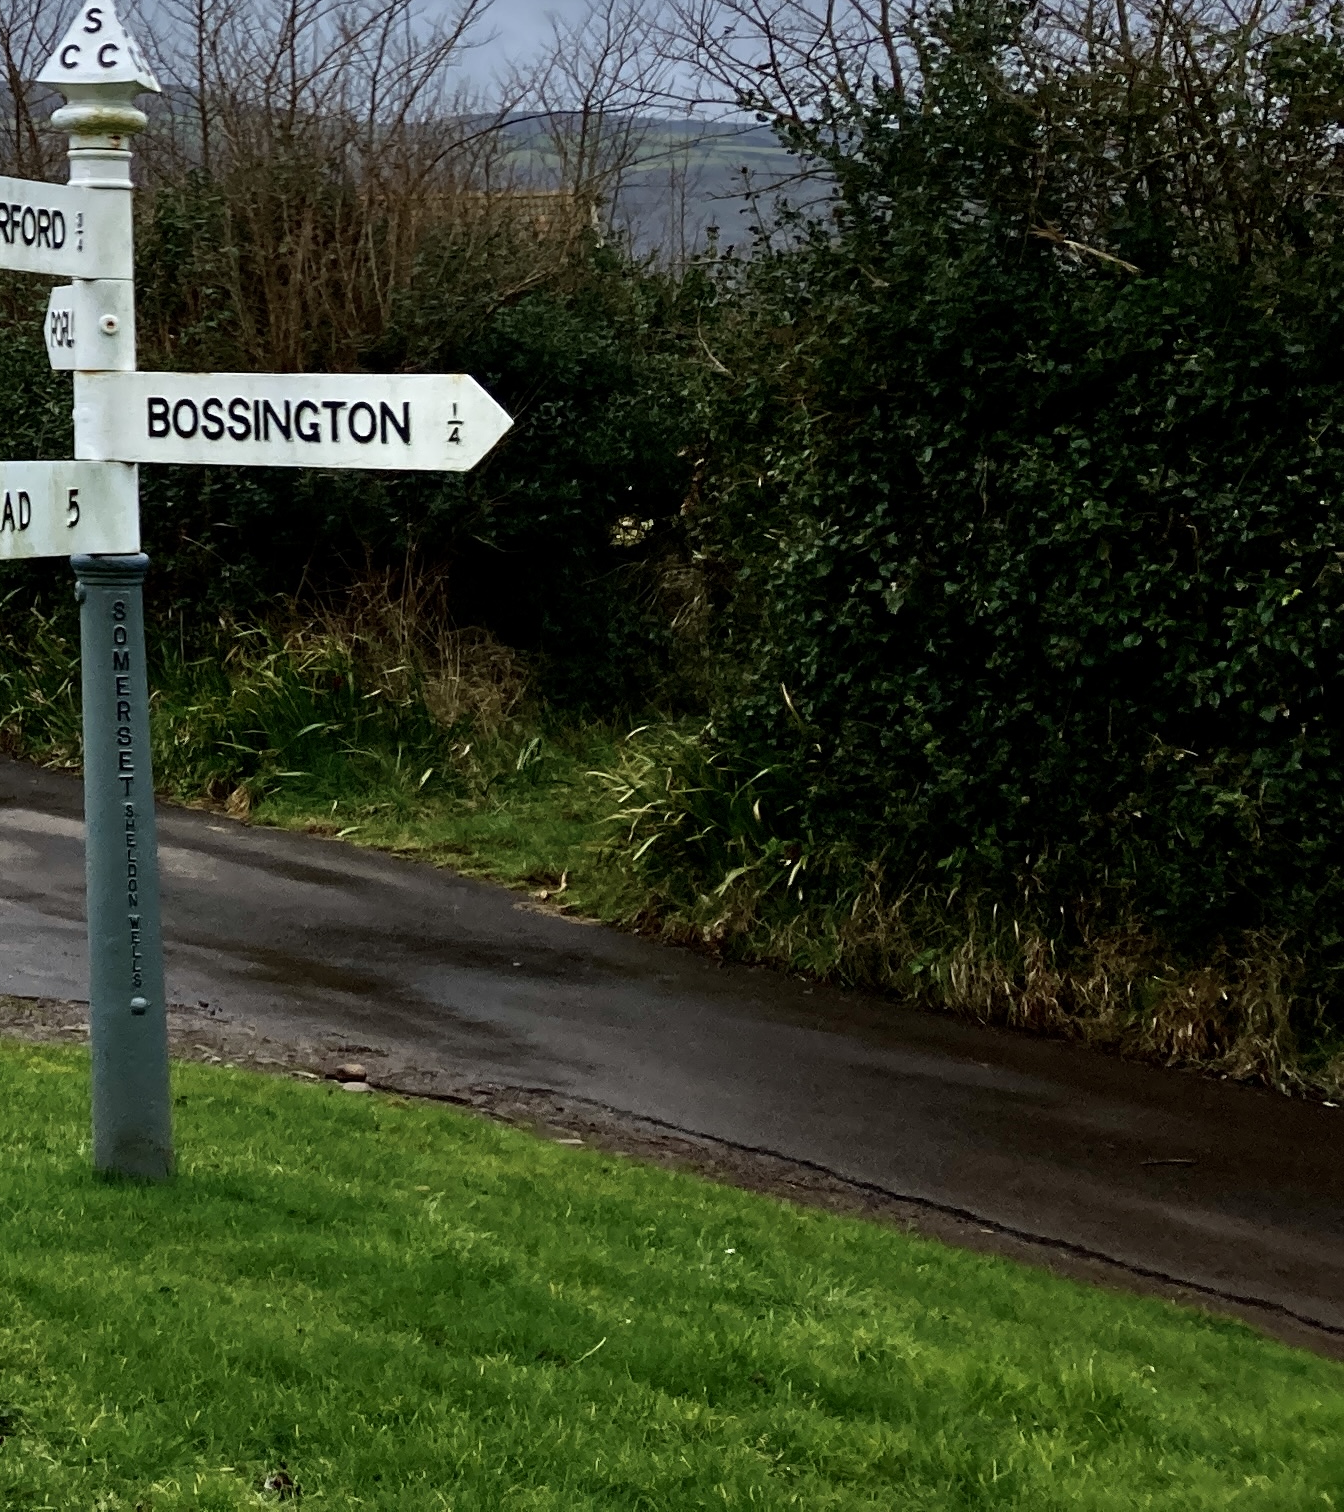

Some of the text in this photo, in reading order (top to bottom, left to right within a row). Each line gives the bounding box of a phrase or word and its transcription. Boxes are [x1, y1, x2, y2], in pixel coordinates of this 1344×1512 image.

[83, 7, 104, 34] S
[146, 396, 412, 446] BOSSINGTON
[66, 488, 81, 529] 5
[113, 600, 135, 798] SOMERSET
[124, 802, 144, 989] SHELDON WELLS
